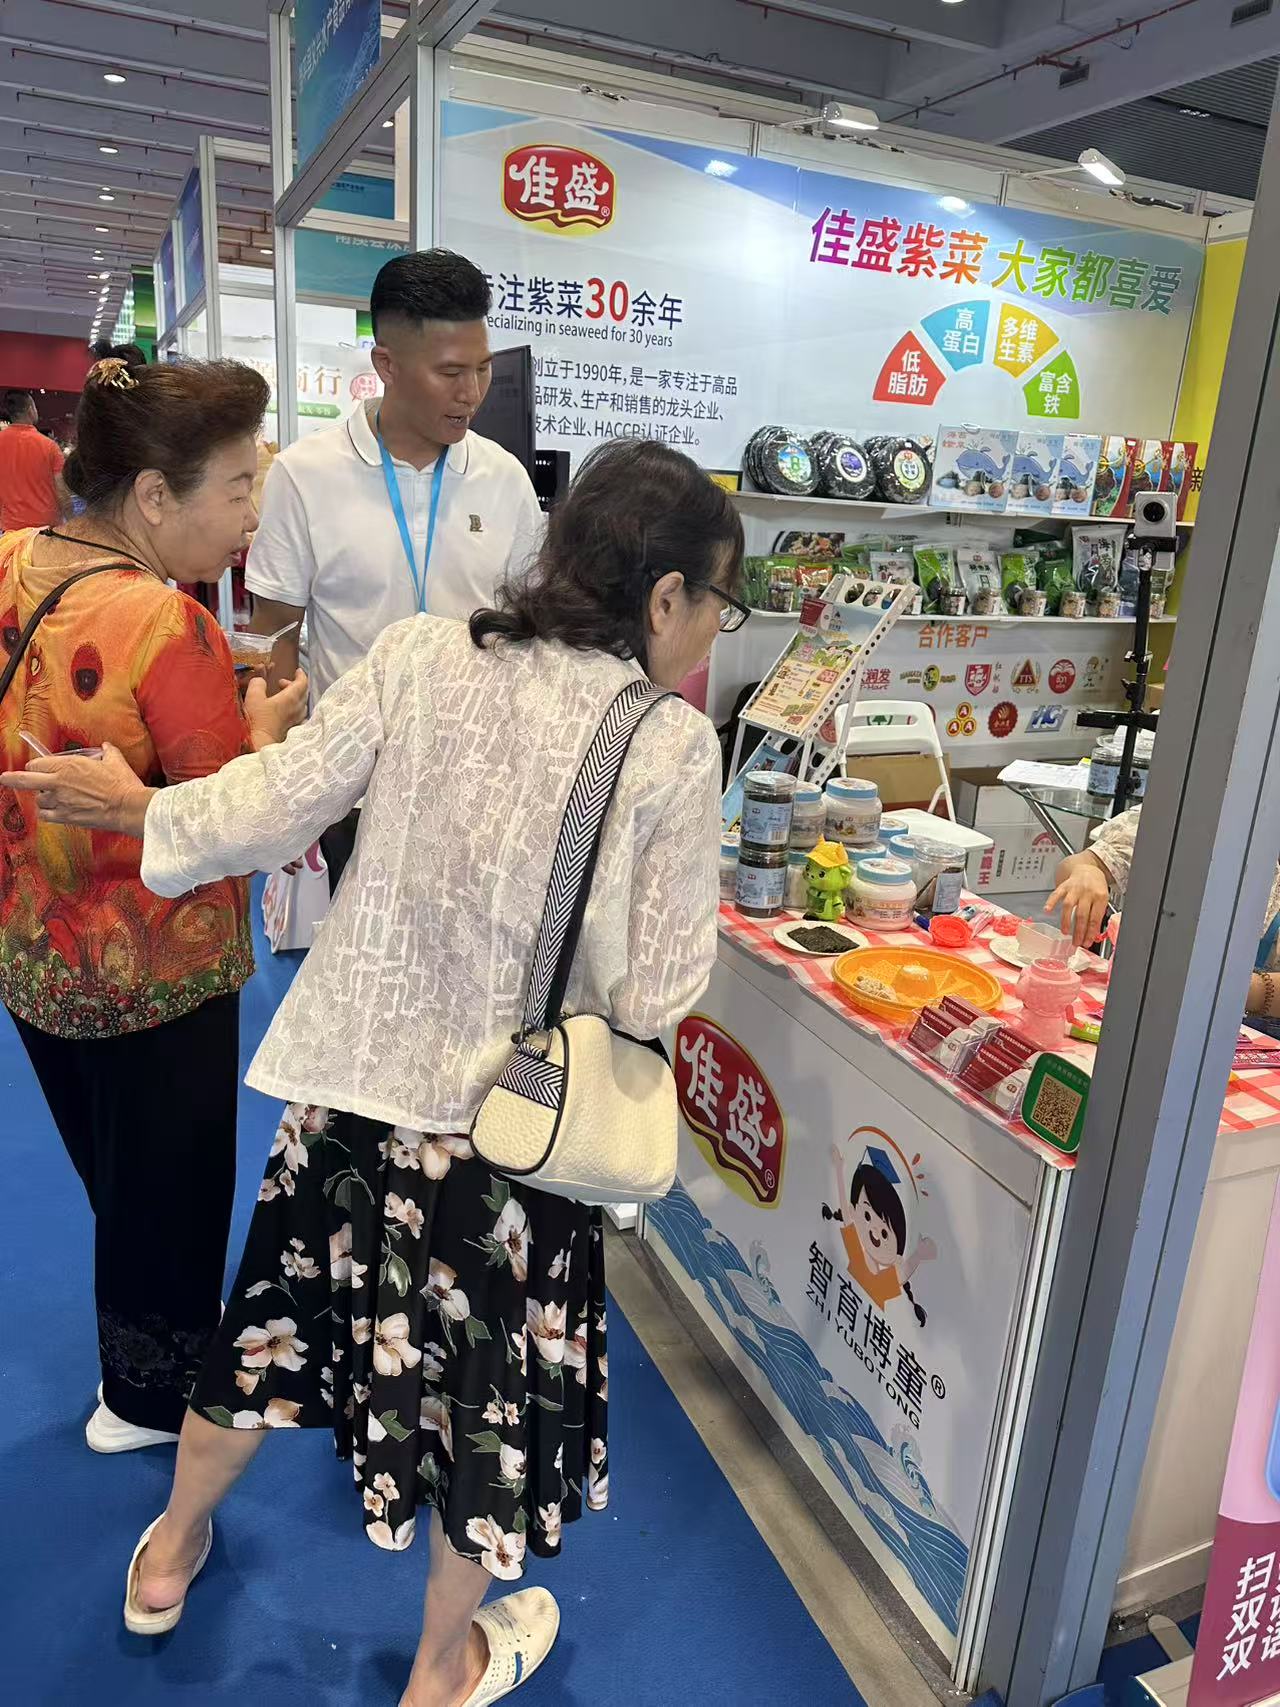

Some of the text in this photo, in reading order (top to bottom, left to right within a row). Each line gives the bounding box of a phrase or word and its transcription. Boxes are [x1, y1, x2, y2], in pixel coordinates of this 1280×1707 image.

[508, 155, 610, 212] 佳盛
[809, 206, 1183, 317] 佳盛紫菜 大家都喜爱
[486, 314, 673, 348] ecializing in seaweed for 30 years
[955, 307, 974, 331] 高
[1002, 316, 1038, 343] 多维
[942, 330, 980, 355] 蛋白
[998, 340, 1035, 365] 生素
[902, 348, 921, 373] 低
[887, 373, 928, 396] 脂肪
[1038, 372, 1073, 394] 富含
[1043, 393, 1061, 415] 铁
[918, 623, 990, 649] 合作客户
[861, 668, 891, 684] 润发
[680, 1032, 777, 1170] 佳盛
[808, 1240, 928, 1414] 智育博童
[1235, 1551, 1280, 1600] 扫
